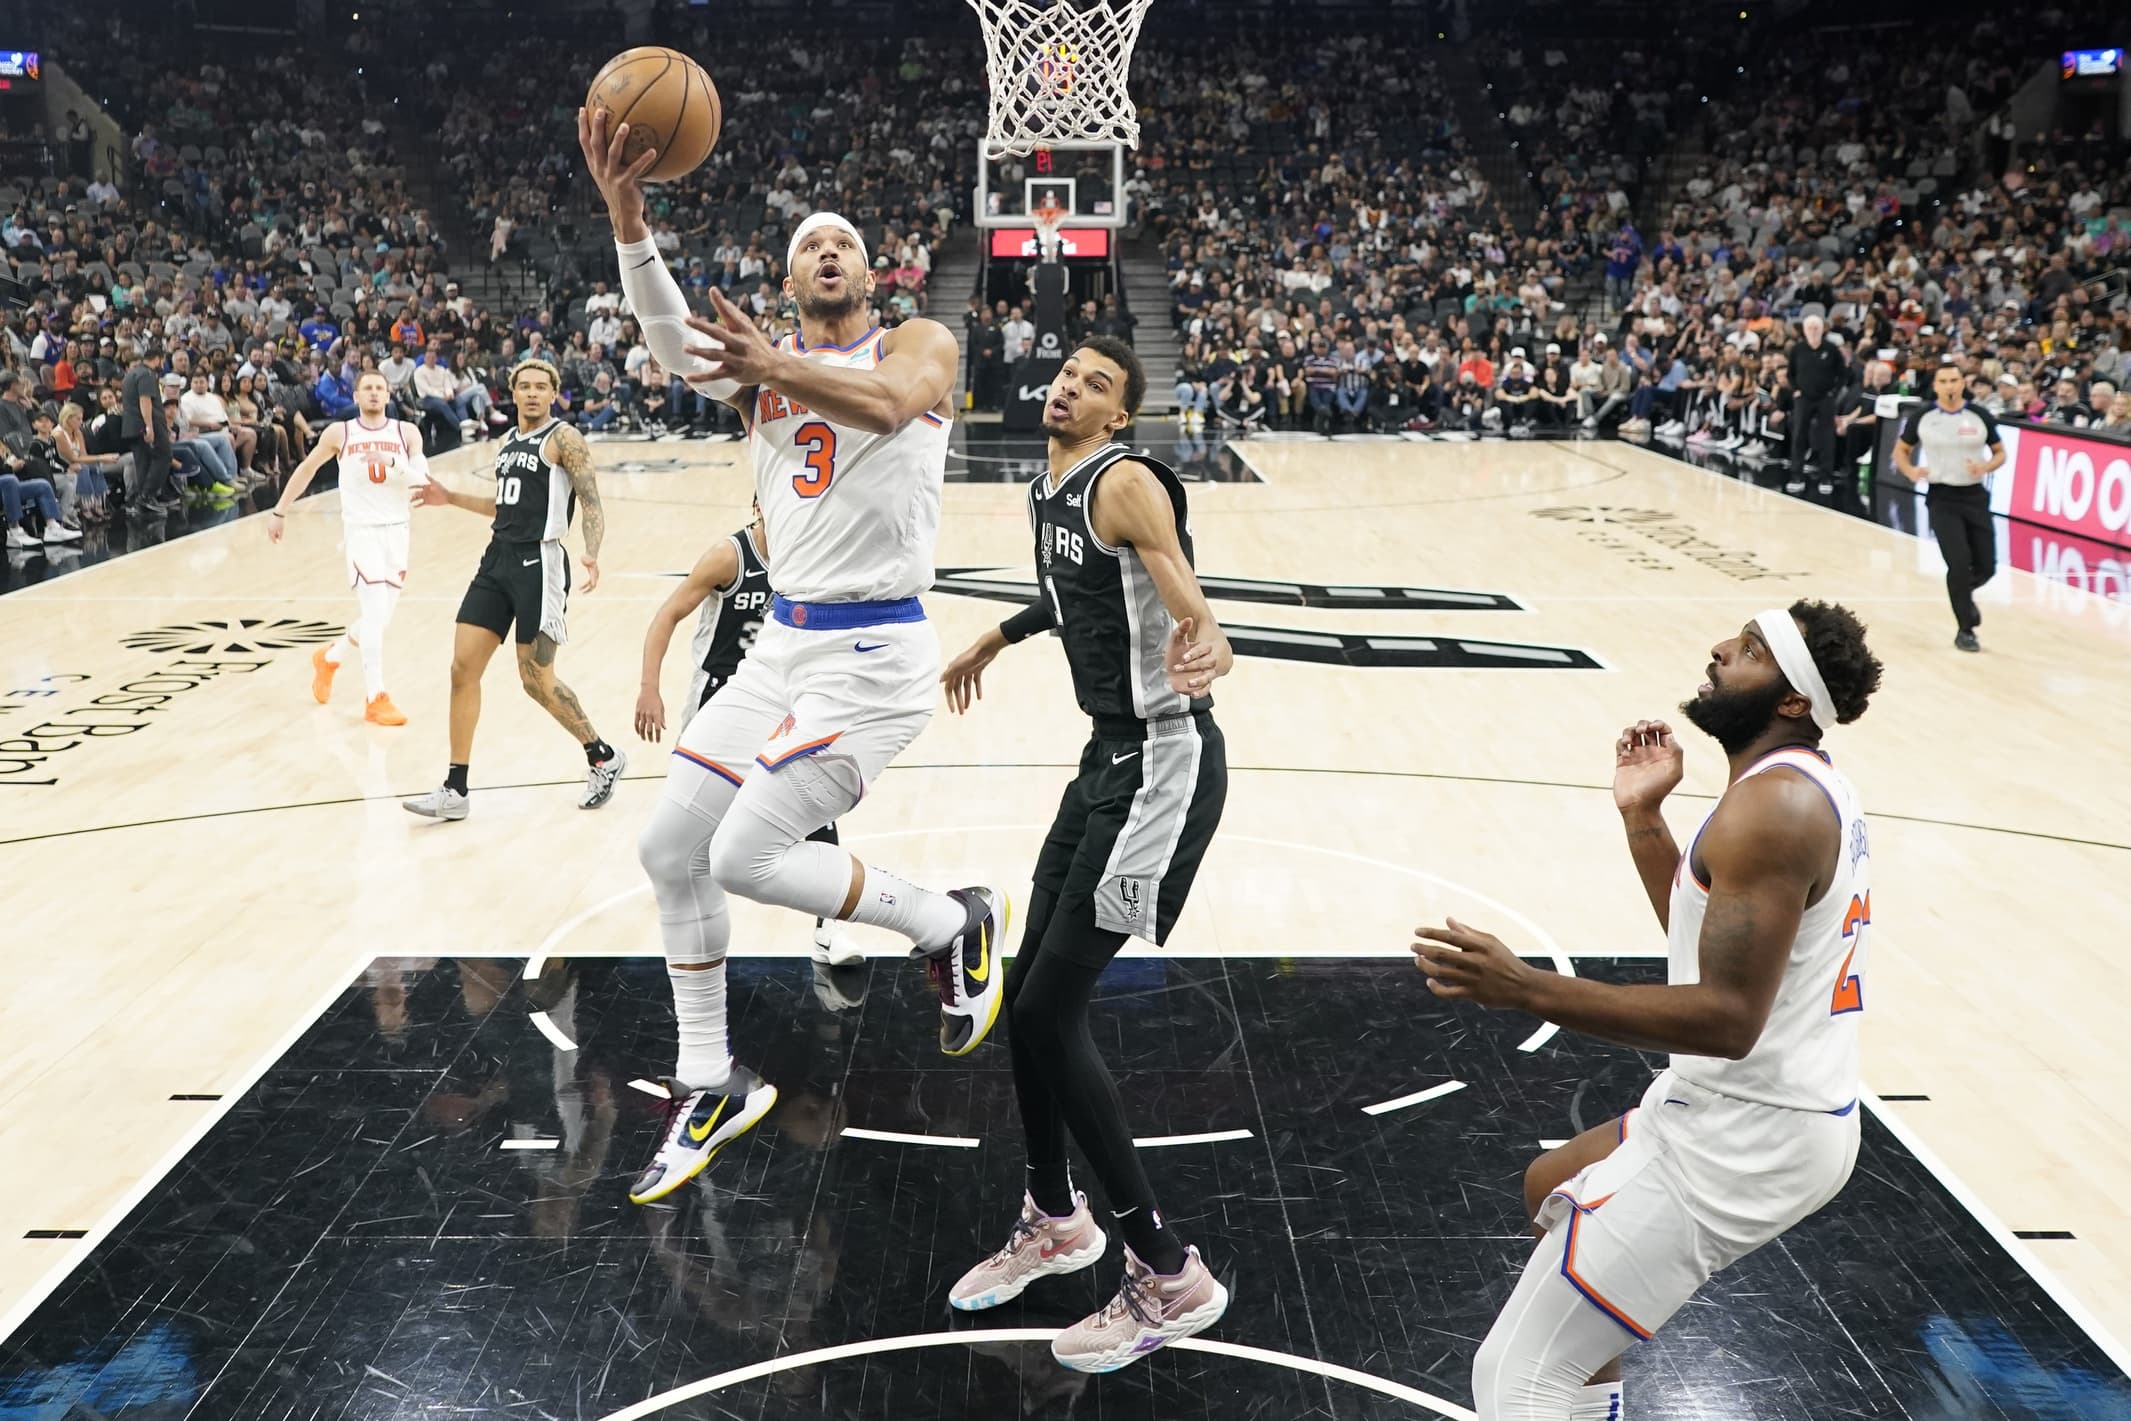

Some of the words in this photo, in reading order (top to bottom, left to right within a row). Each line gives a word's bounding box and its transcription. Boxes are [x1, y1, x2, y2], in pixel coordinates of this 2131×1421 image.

[347, 442, 371, 456] NEW
[374, 441, 401, 455] YORK
[792, 421, 837, 499] 3
[495, 476, 521, 505] 10
[2033, 445, 2095, 521] NO
[2097, 458, 2131, 536] O
[1044, 574, 1064, 626] 1
